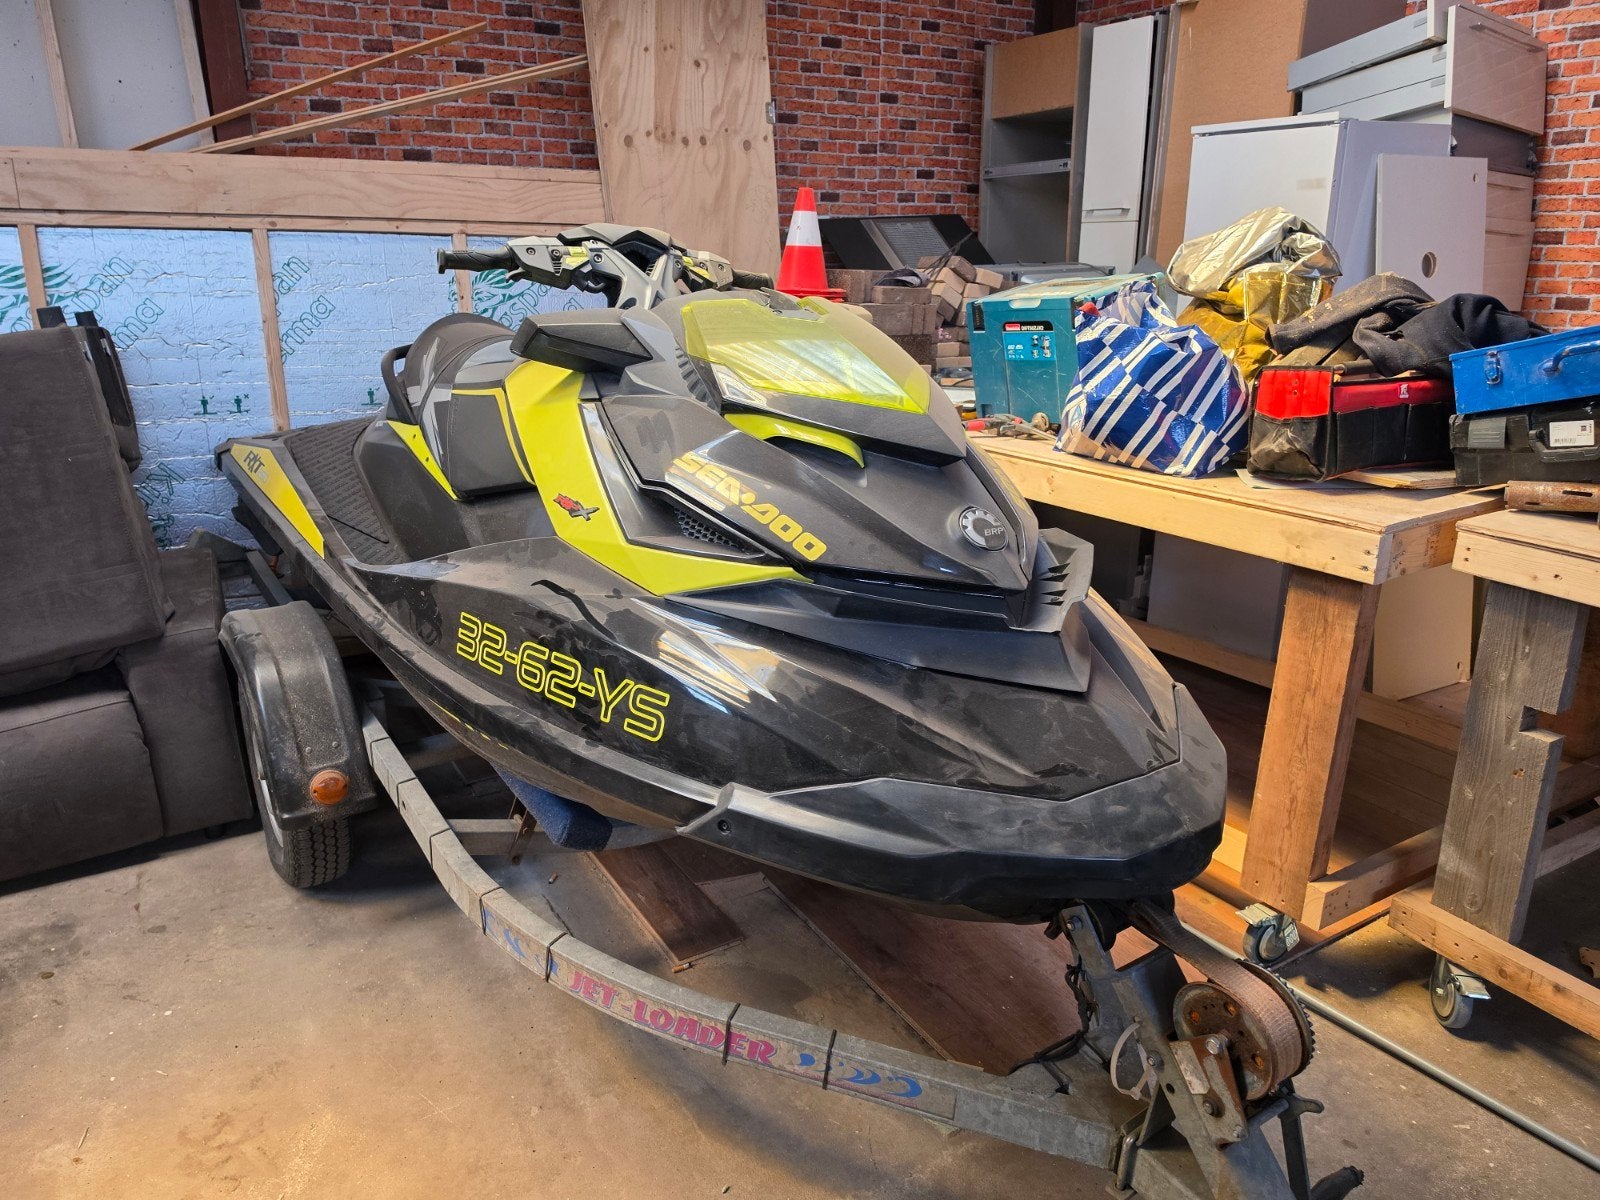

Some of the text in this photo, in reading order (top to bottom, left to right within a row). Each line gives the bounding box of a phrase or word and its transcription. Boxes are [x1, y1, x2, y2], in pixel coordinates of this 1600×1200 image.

[243, 450, 266, 474] RXT
[984, 527, 1005, 537] BRP
[456, 611, 670, 742] 32-62-YS
